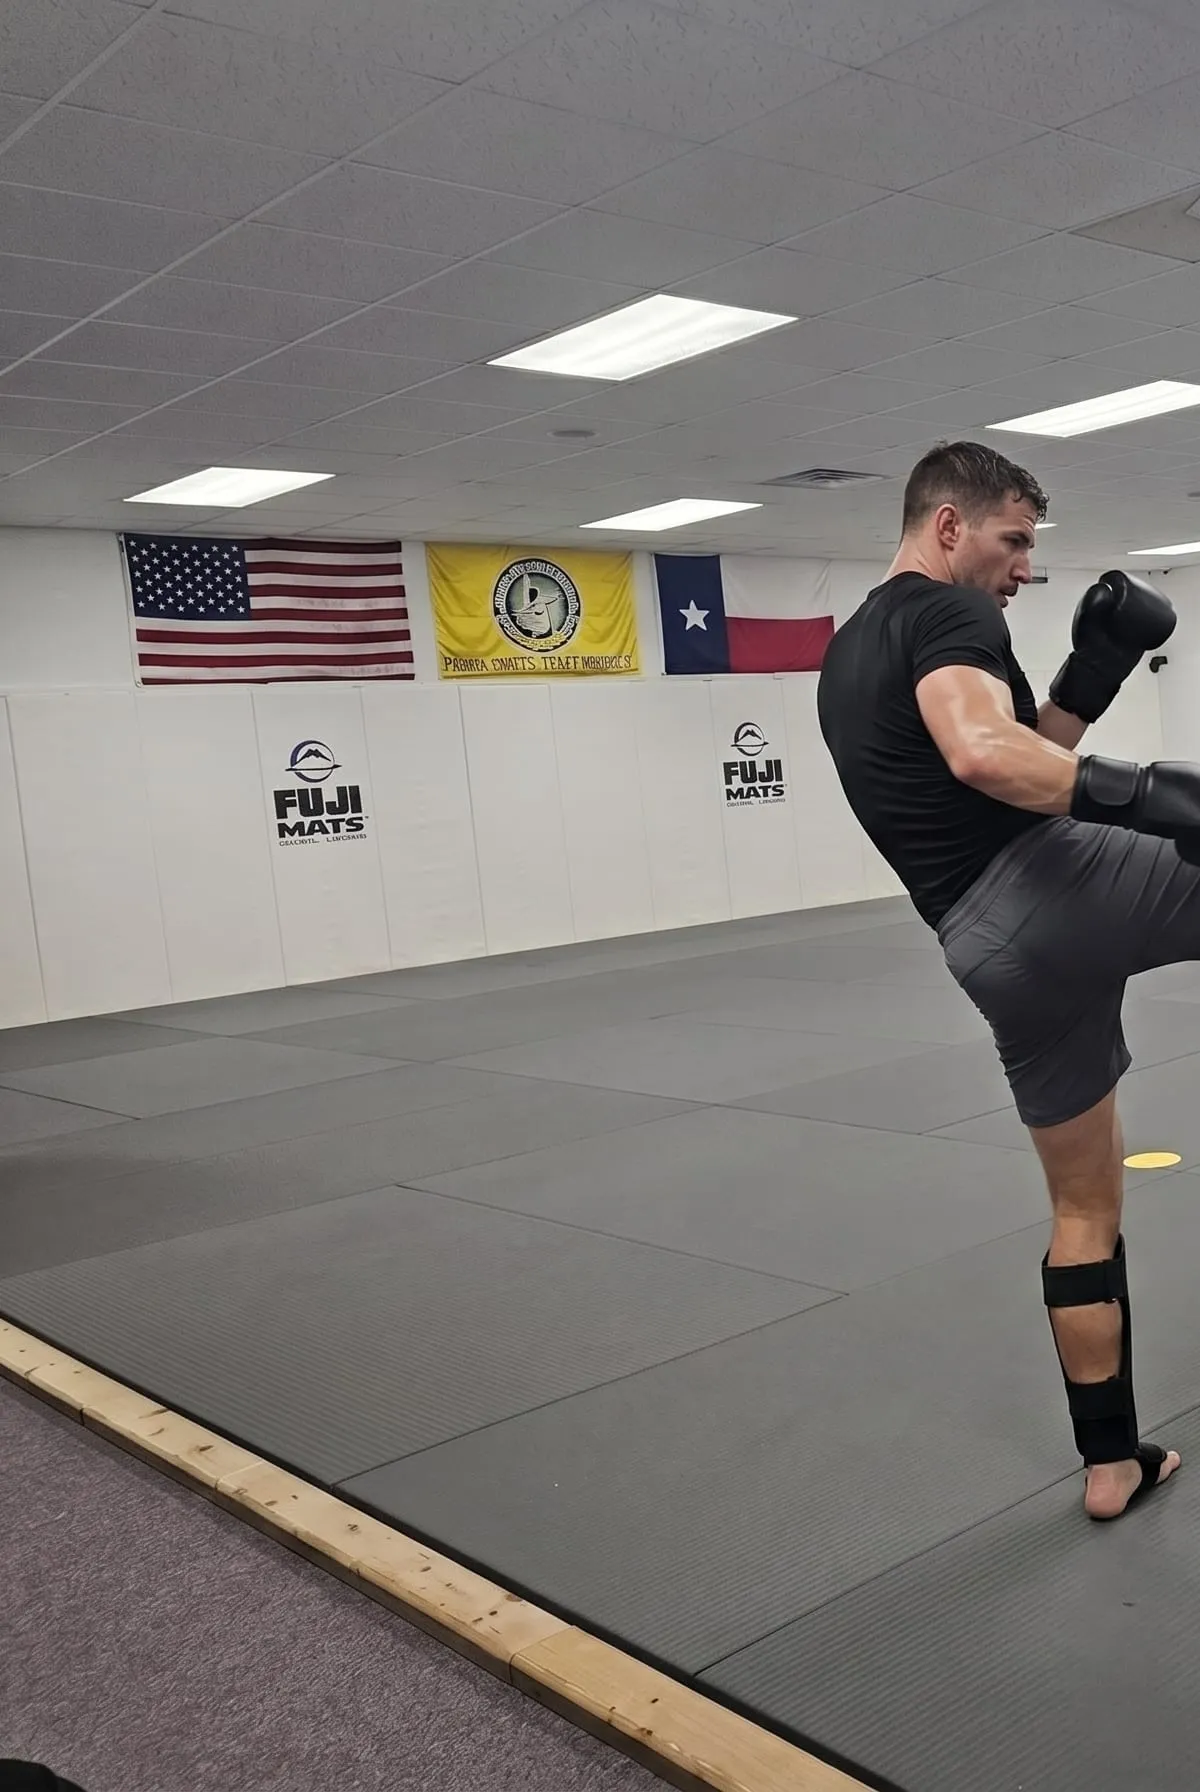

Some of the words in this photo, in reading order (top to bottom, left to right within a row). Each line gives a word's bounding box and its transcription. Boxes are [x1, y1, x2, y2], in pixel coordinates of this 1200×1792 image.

[723, 759, 783, 785] FUJI
[273, 785, 362, 820] FUJI
[726, 784, 785, 801] MATS
[277, 816, 365, 839] MATS
